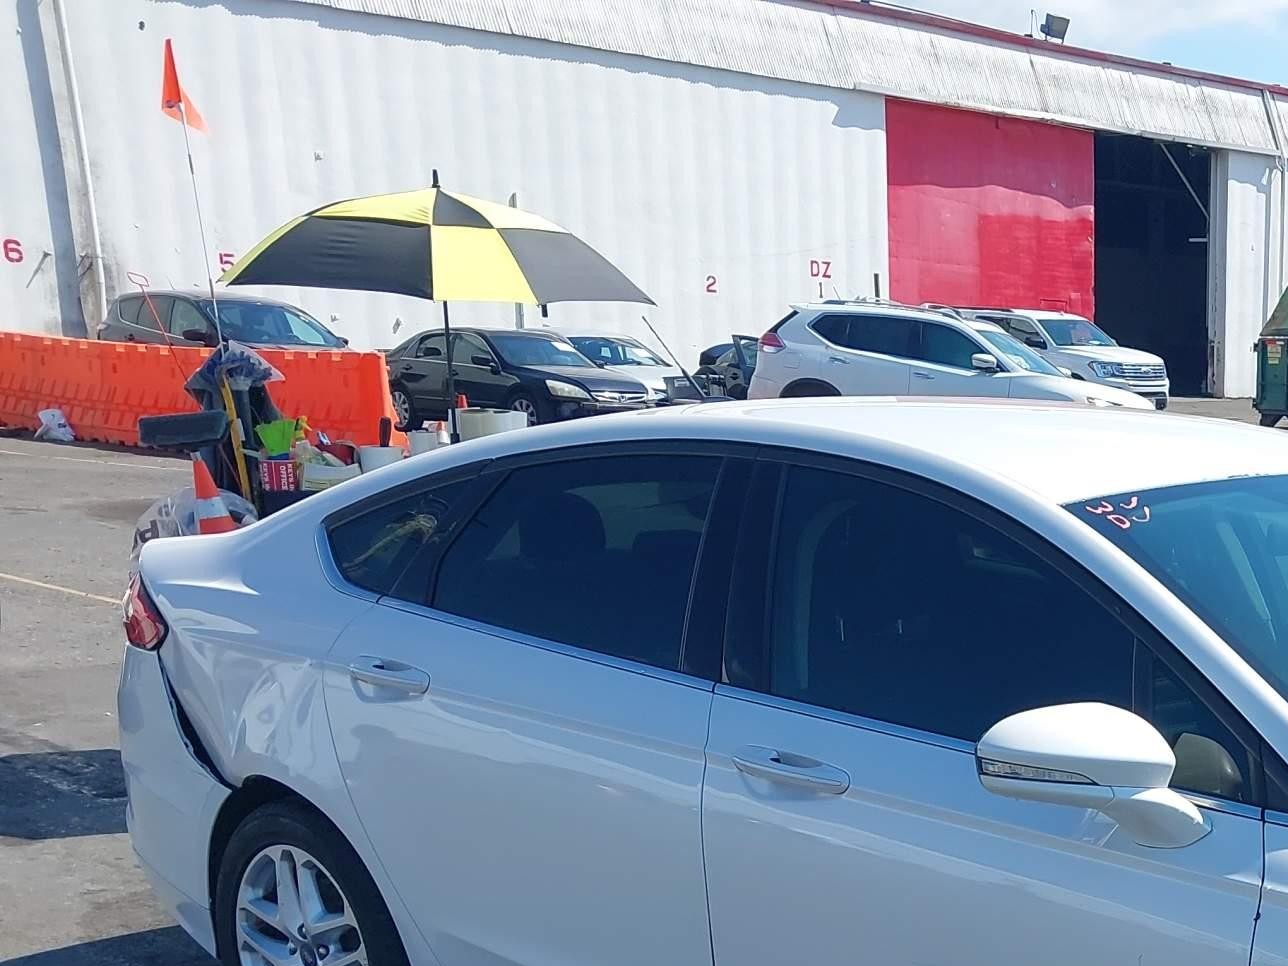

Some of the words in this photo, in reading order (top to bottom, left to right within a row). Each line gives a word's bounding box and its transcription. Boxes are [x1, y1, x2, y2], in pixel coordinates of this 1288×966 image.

[3, 238, 24, 263] 6
[219, 252, 235, 272] 5
[810, 259, 832, 278] DZ
[705, 275, 717, 293] 2
